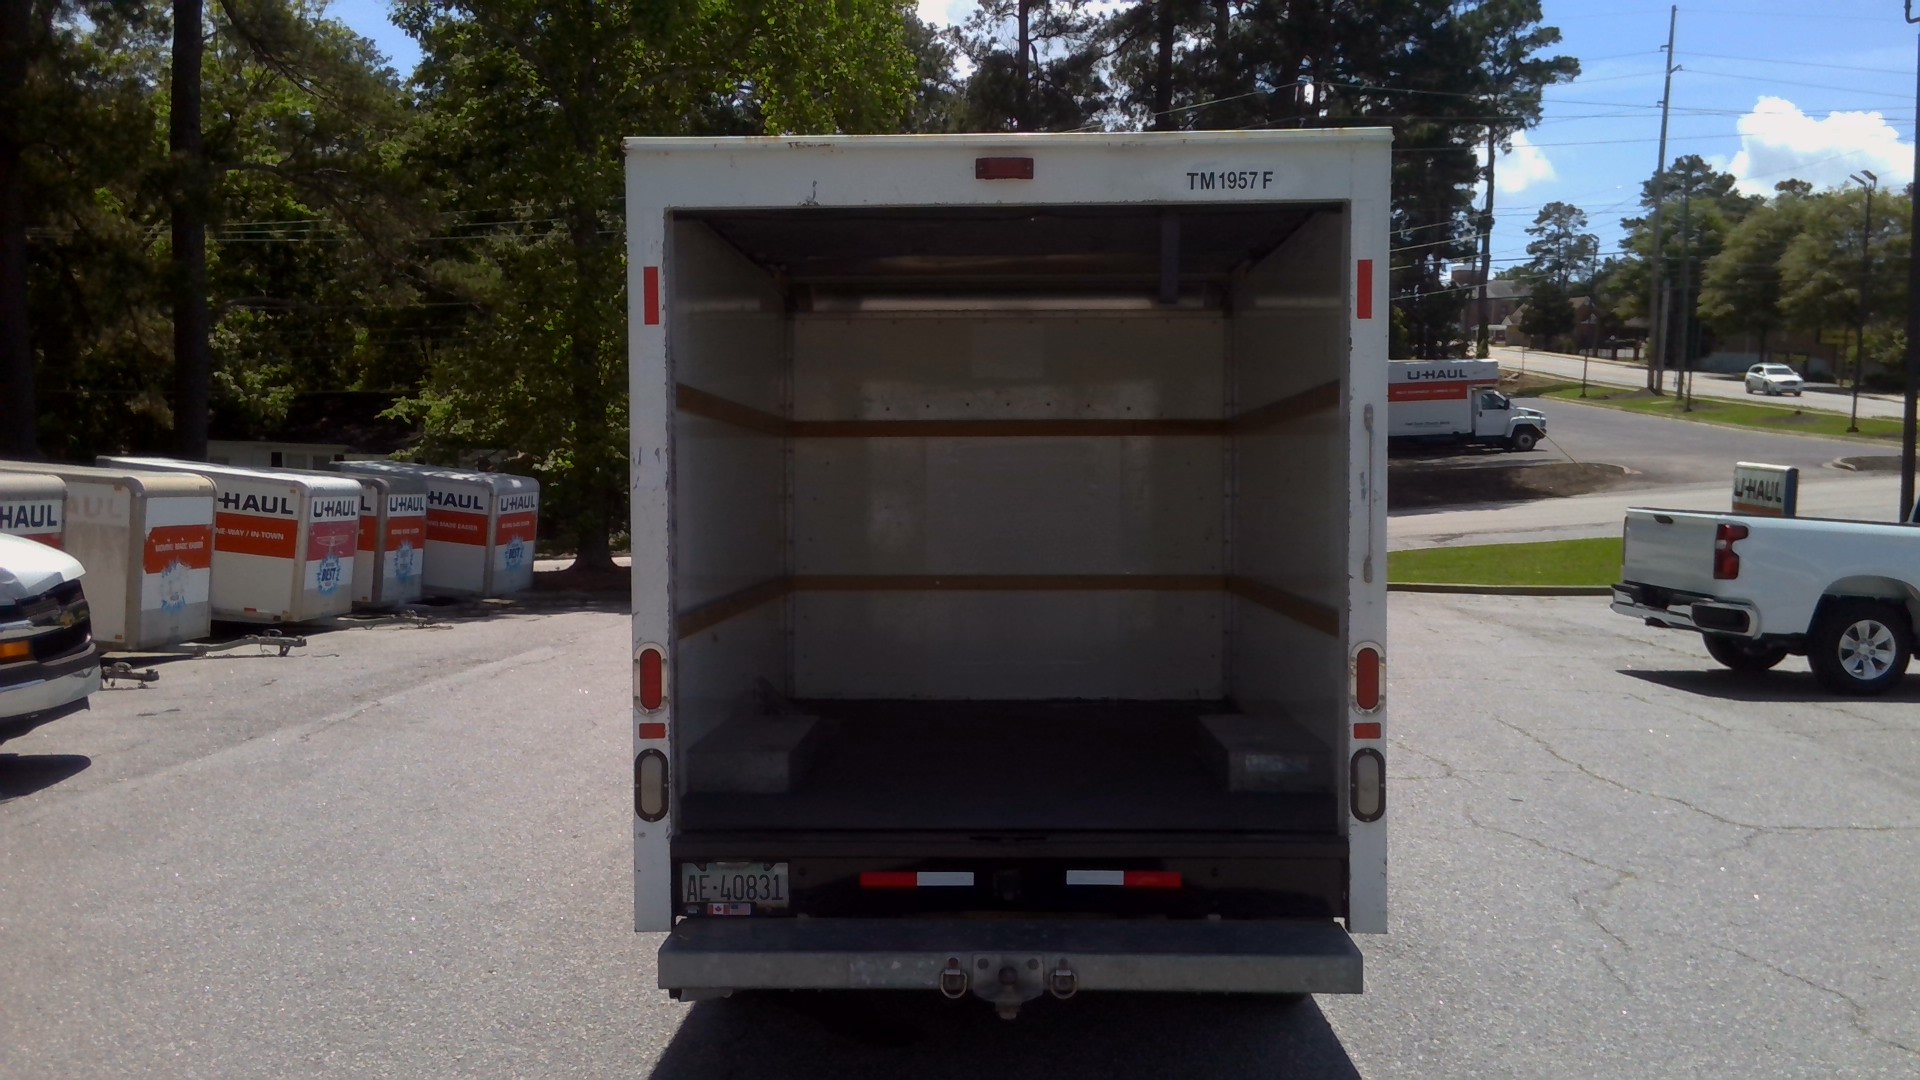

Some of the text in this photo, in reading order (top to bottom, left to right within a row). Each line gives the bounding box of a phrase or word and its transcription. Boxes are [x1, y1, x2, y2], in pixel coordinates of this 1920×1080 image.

[1407, 369, 1467, 380] U-HAUL
[1734, 478, 1782, 503] U-HAUL
[218, 492, 294, 515] -HAUL
[313, 500, 356, 517] U-HAUL
[389, 497, 424, 511] U-HAUL
[428, 491, 484, 510] -HAUL
[501, 496, 535, 511] U-HAUL
[0, 504, 57, 528] HAUL
[215, 527, 245, 537] NE-WAY
